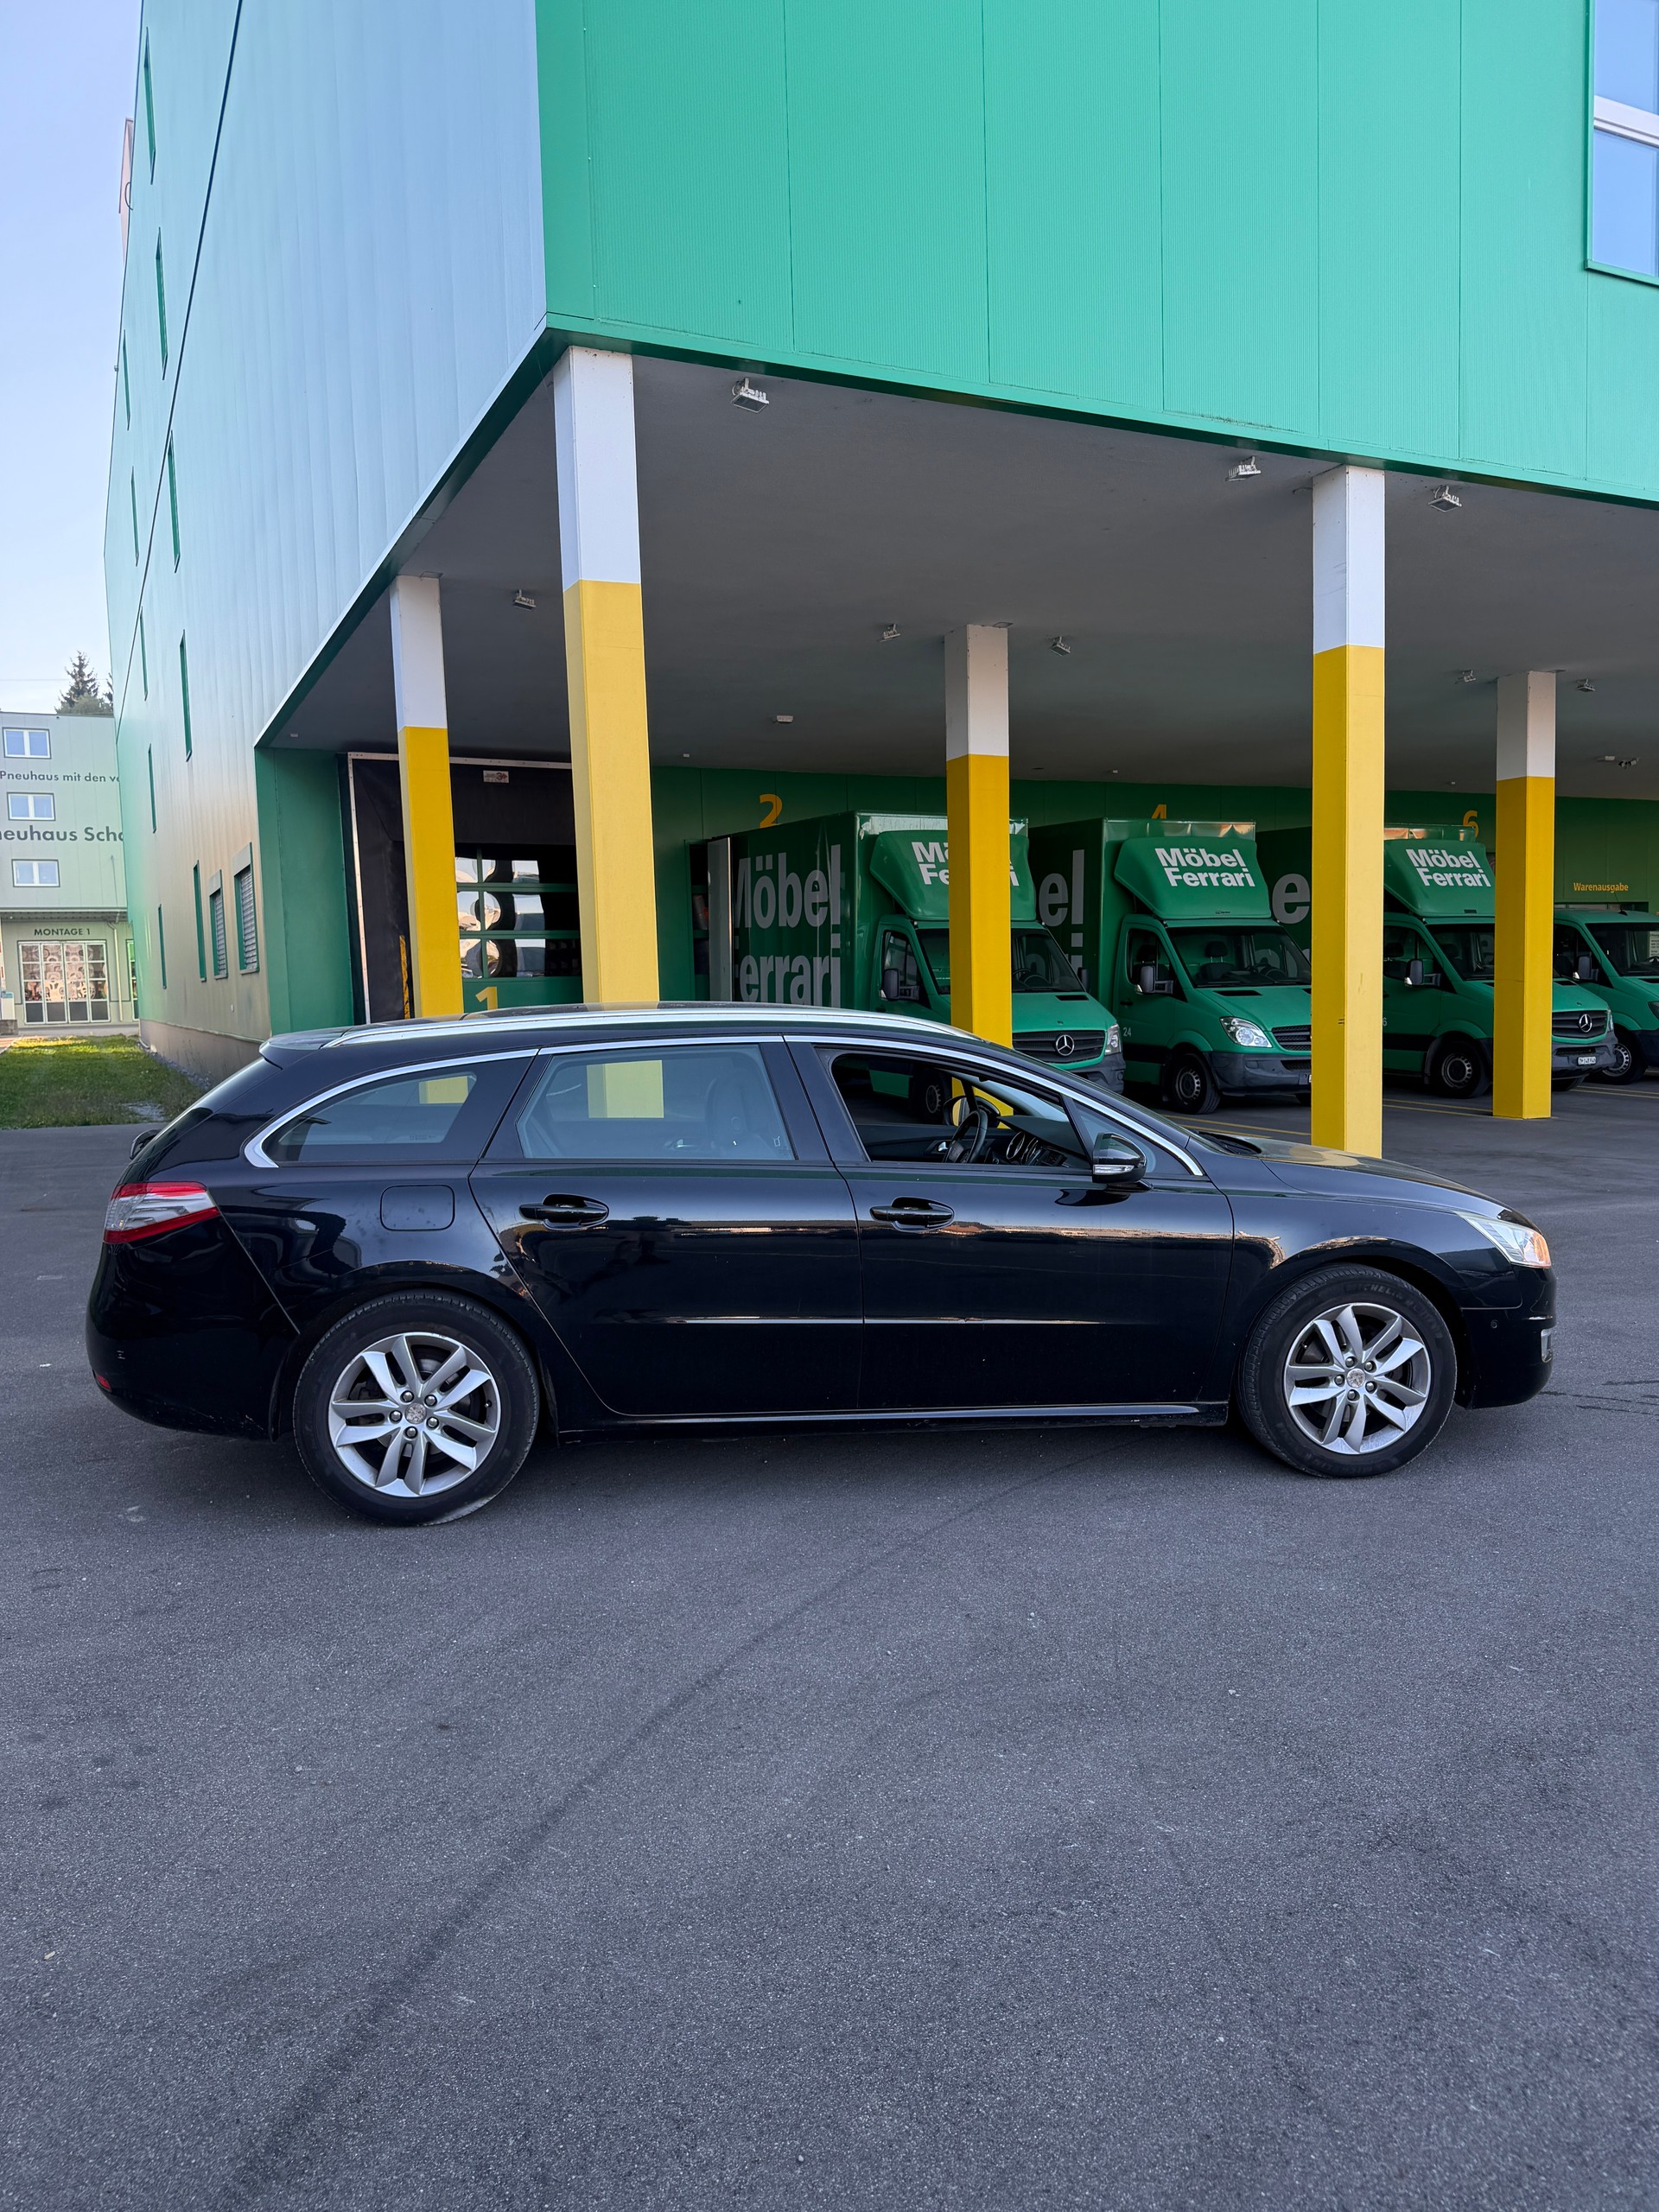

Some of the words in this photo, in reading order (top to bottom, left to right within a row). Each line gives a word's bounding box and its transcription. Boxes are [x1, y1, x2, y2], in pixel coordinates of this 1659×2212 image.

[0, 771, 59, 781] Pneuhaus
[62, 772, 81, 781] mit
[84, 772, 106, 782] den
[760, 793, 783, 829] 2
[0, 825, 78, 842] euhaus
[1154, 848, 1247, 868] Möbel
[1405, 849, 1481, 868] Möbel
[1163, 867, 1255, 887] Ferrari
[1415, 868, 1491, 887] Ferrari
[1573, 881, 1629, 893] Warenausgabe
[735, 932, 842, 1008] errari
[1122, 1027, 1132, 1037] 24
